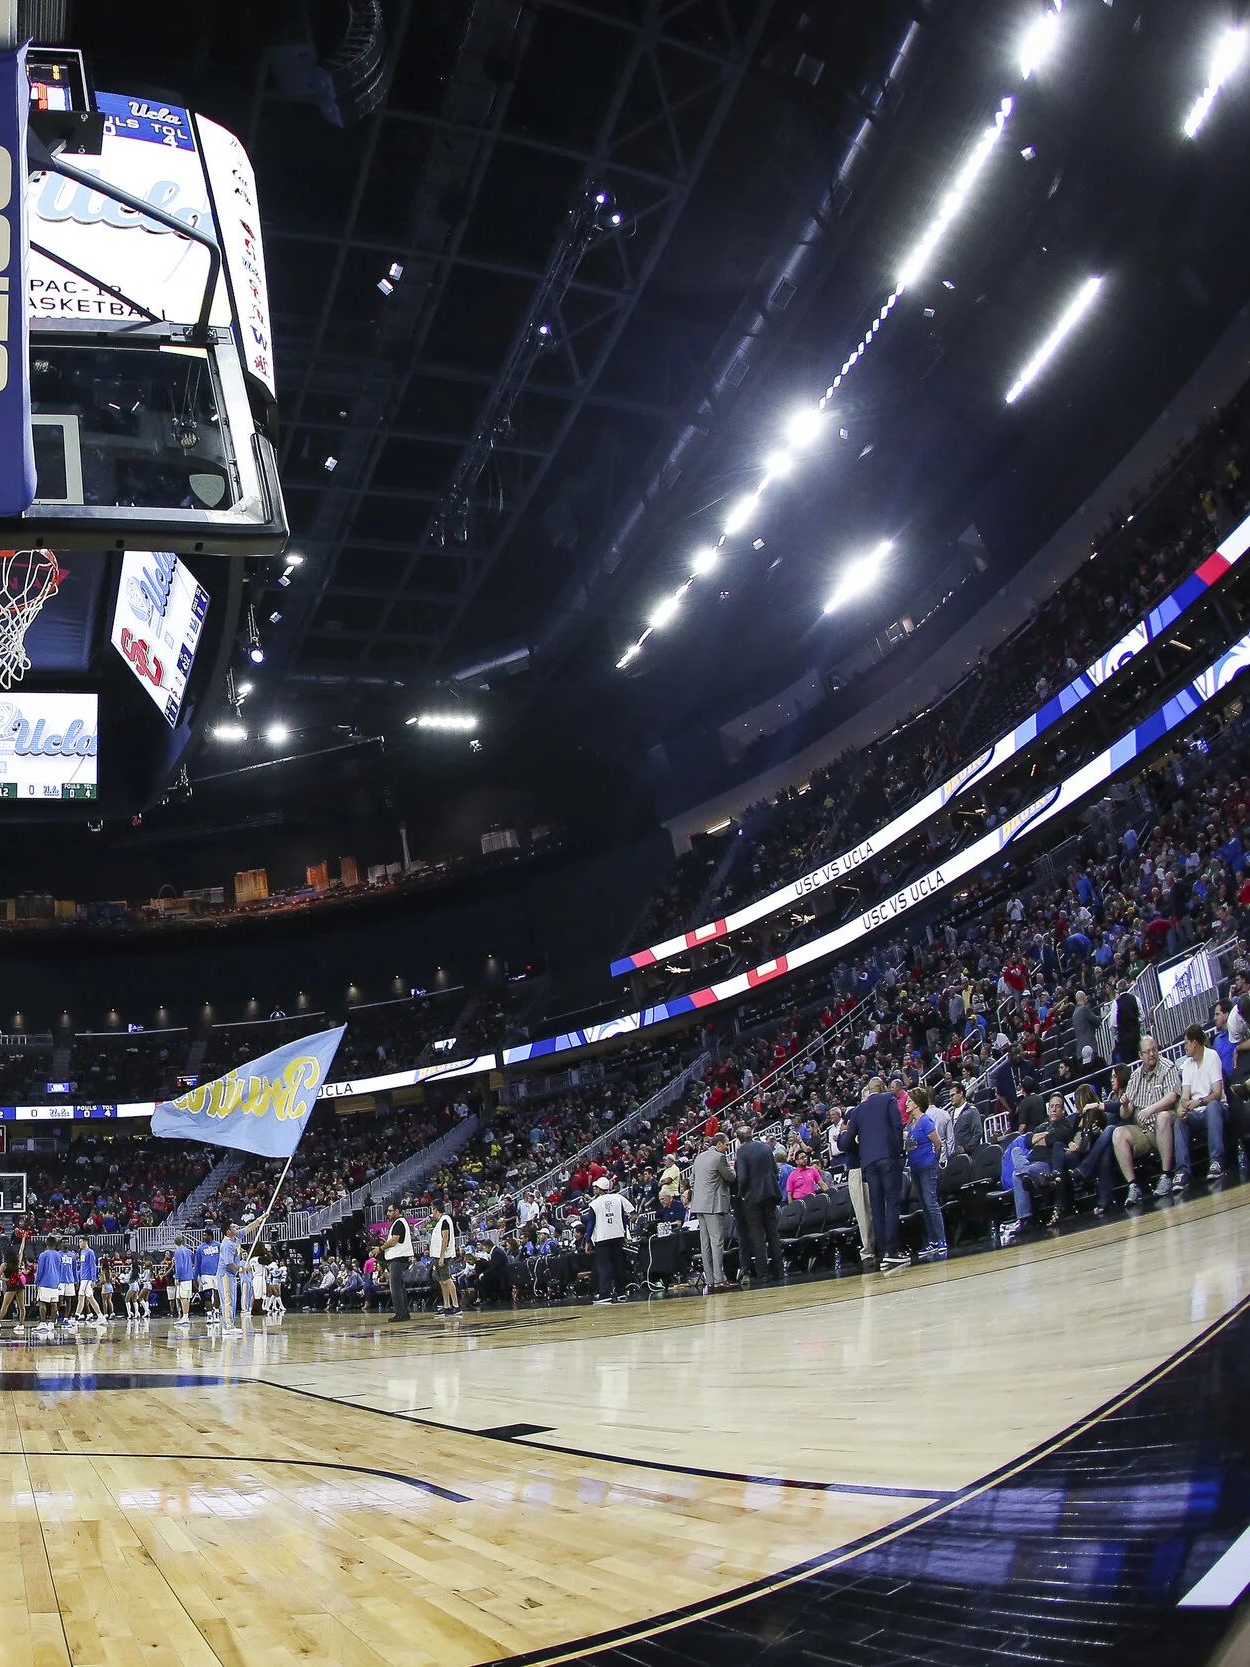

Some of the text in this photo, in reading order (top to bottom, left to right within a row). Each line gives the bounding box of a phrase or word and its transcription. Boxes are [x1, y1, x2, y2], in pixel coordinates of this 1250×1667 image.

[129, 101, 183, 126] Ucla
[151, 123, 188, 140] TOL
[162, 135, 178, 147] 4
[12, 718, 98, 757] Ucla
[29, 784, 35, 795] 0
[85, 789, 91, 798] 4
[795, 841, 875, 896] USC VS UCLA
[862, 870, 946, 930] USC VS UCLA
[31, 1109, 38, 1118] 0
